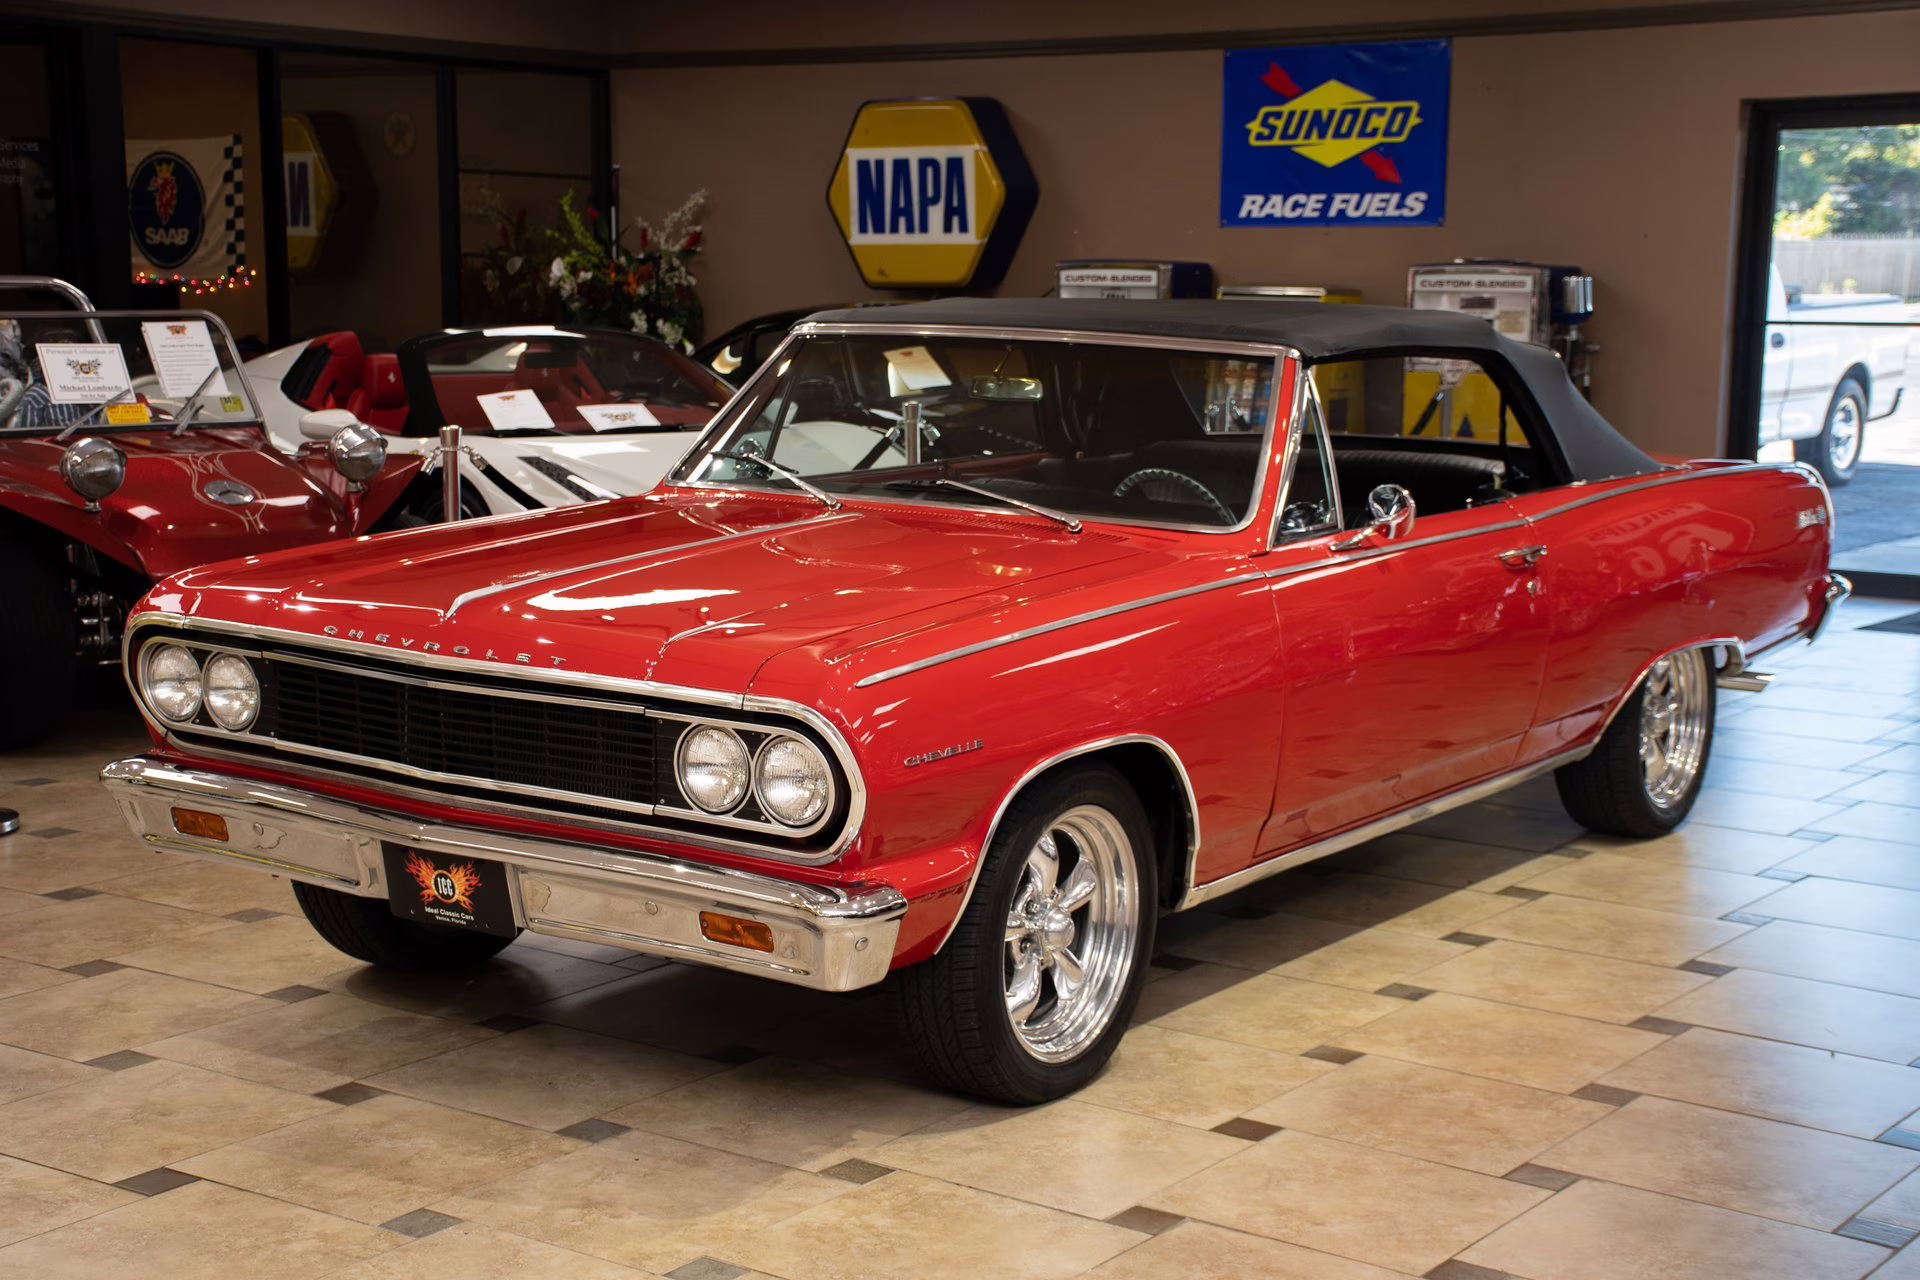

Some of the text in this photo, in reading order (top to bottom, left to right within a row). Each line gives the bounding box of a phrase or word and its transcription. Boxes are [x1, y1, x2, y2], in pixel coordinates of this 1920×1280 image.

[1256, 105, 1409, 142] SUNOCO
[857, 157, 968, 234] NAPA
[1239, 191, 1430, 218] RACE FUELS
[144, 227, 190, 246] SAAB
[323, 625, 566, 666] CHEVROLET
[903, 739, 984, 766] CHEVELLE
[437, 876, 453, 896] ICC
[425, 906, 474, 921] Ideal Classic Cars
